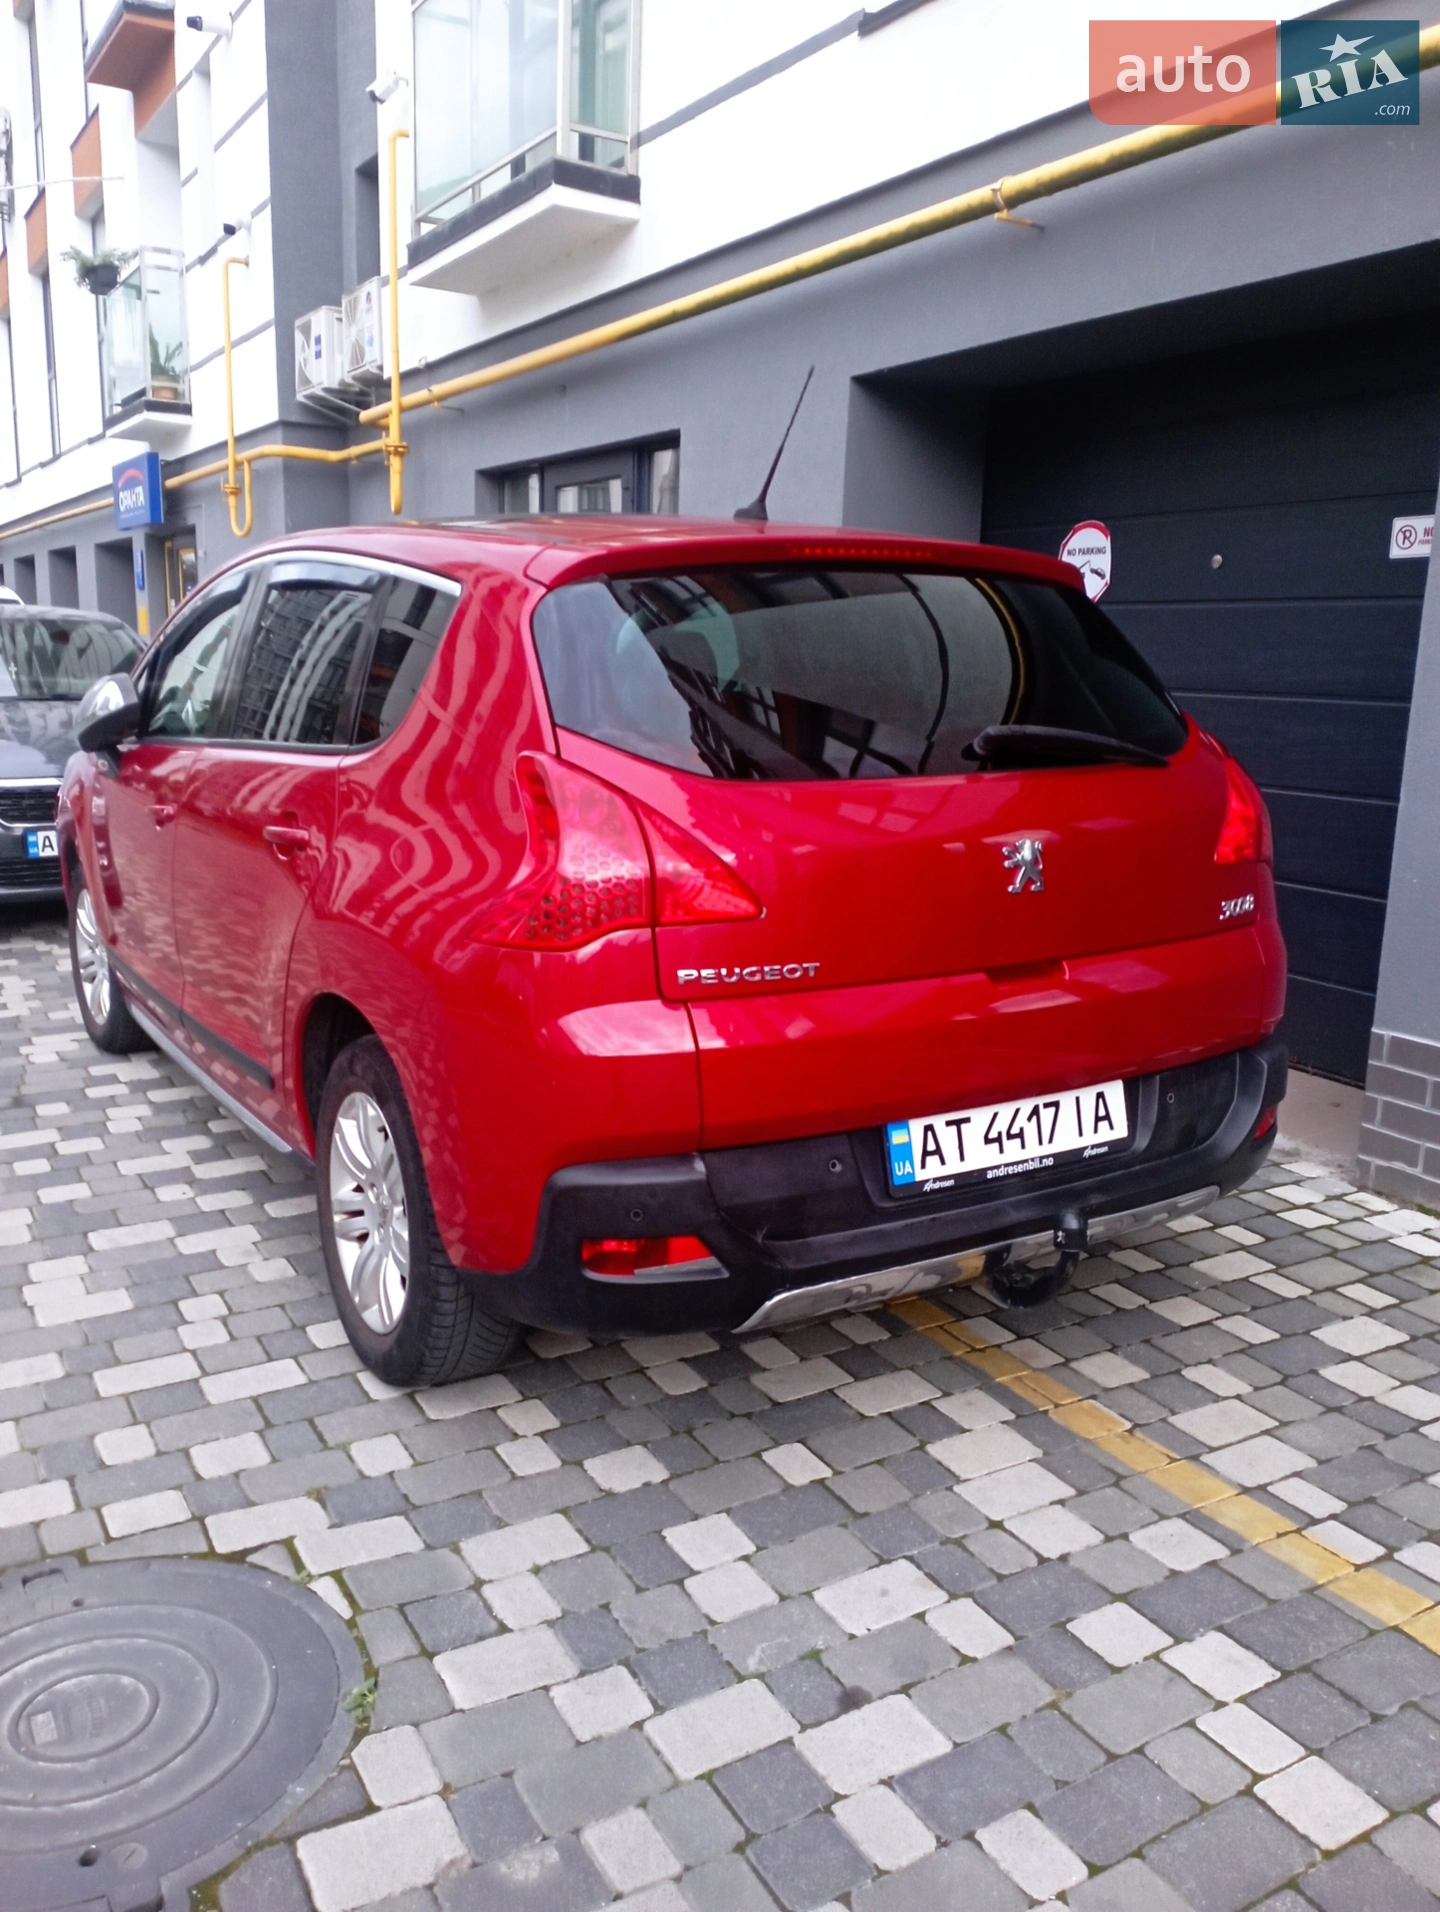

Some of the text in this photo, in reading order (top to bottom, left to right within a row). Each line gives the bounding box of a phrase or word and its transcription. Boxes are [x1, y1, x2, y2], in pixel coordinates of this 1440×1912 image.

[1067, 546, 1106, 557] NO PARKING
[1219, 894, 1254, 920] 3008
[676, 962, 820, 985] PEUGEOT
[920, 1091, 1114, 1170] AT 4417 IA
[894, 1159, 913, 1176] UA
[986, 1156, 1054, 1179] andresenbil.no
[923, 1178, 955, 1192] Andresen
